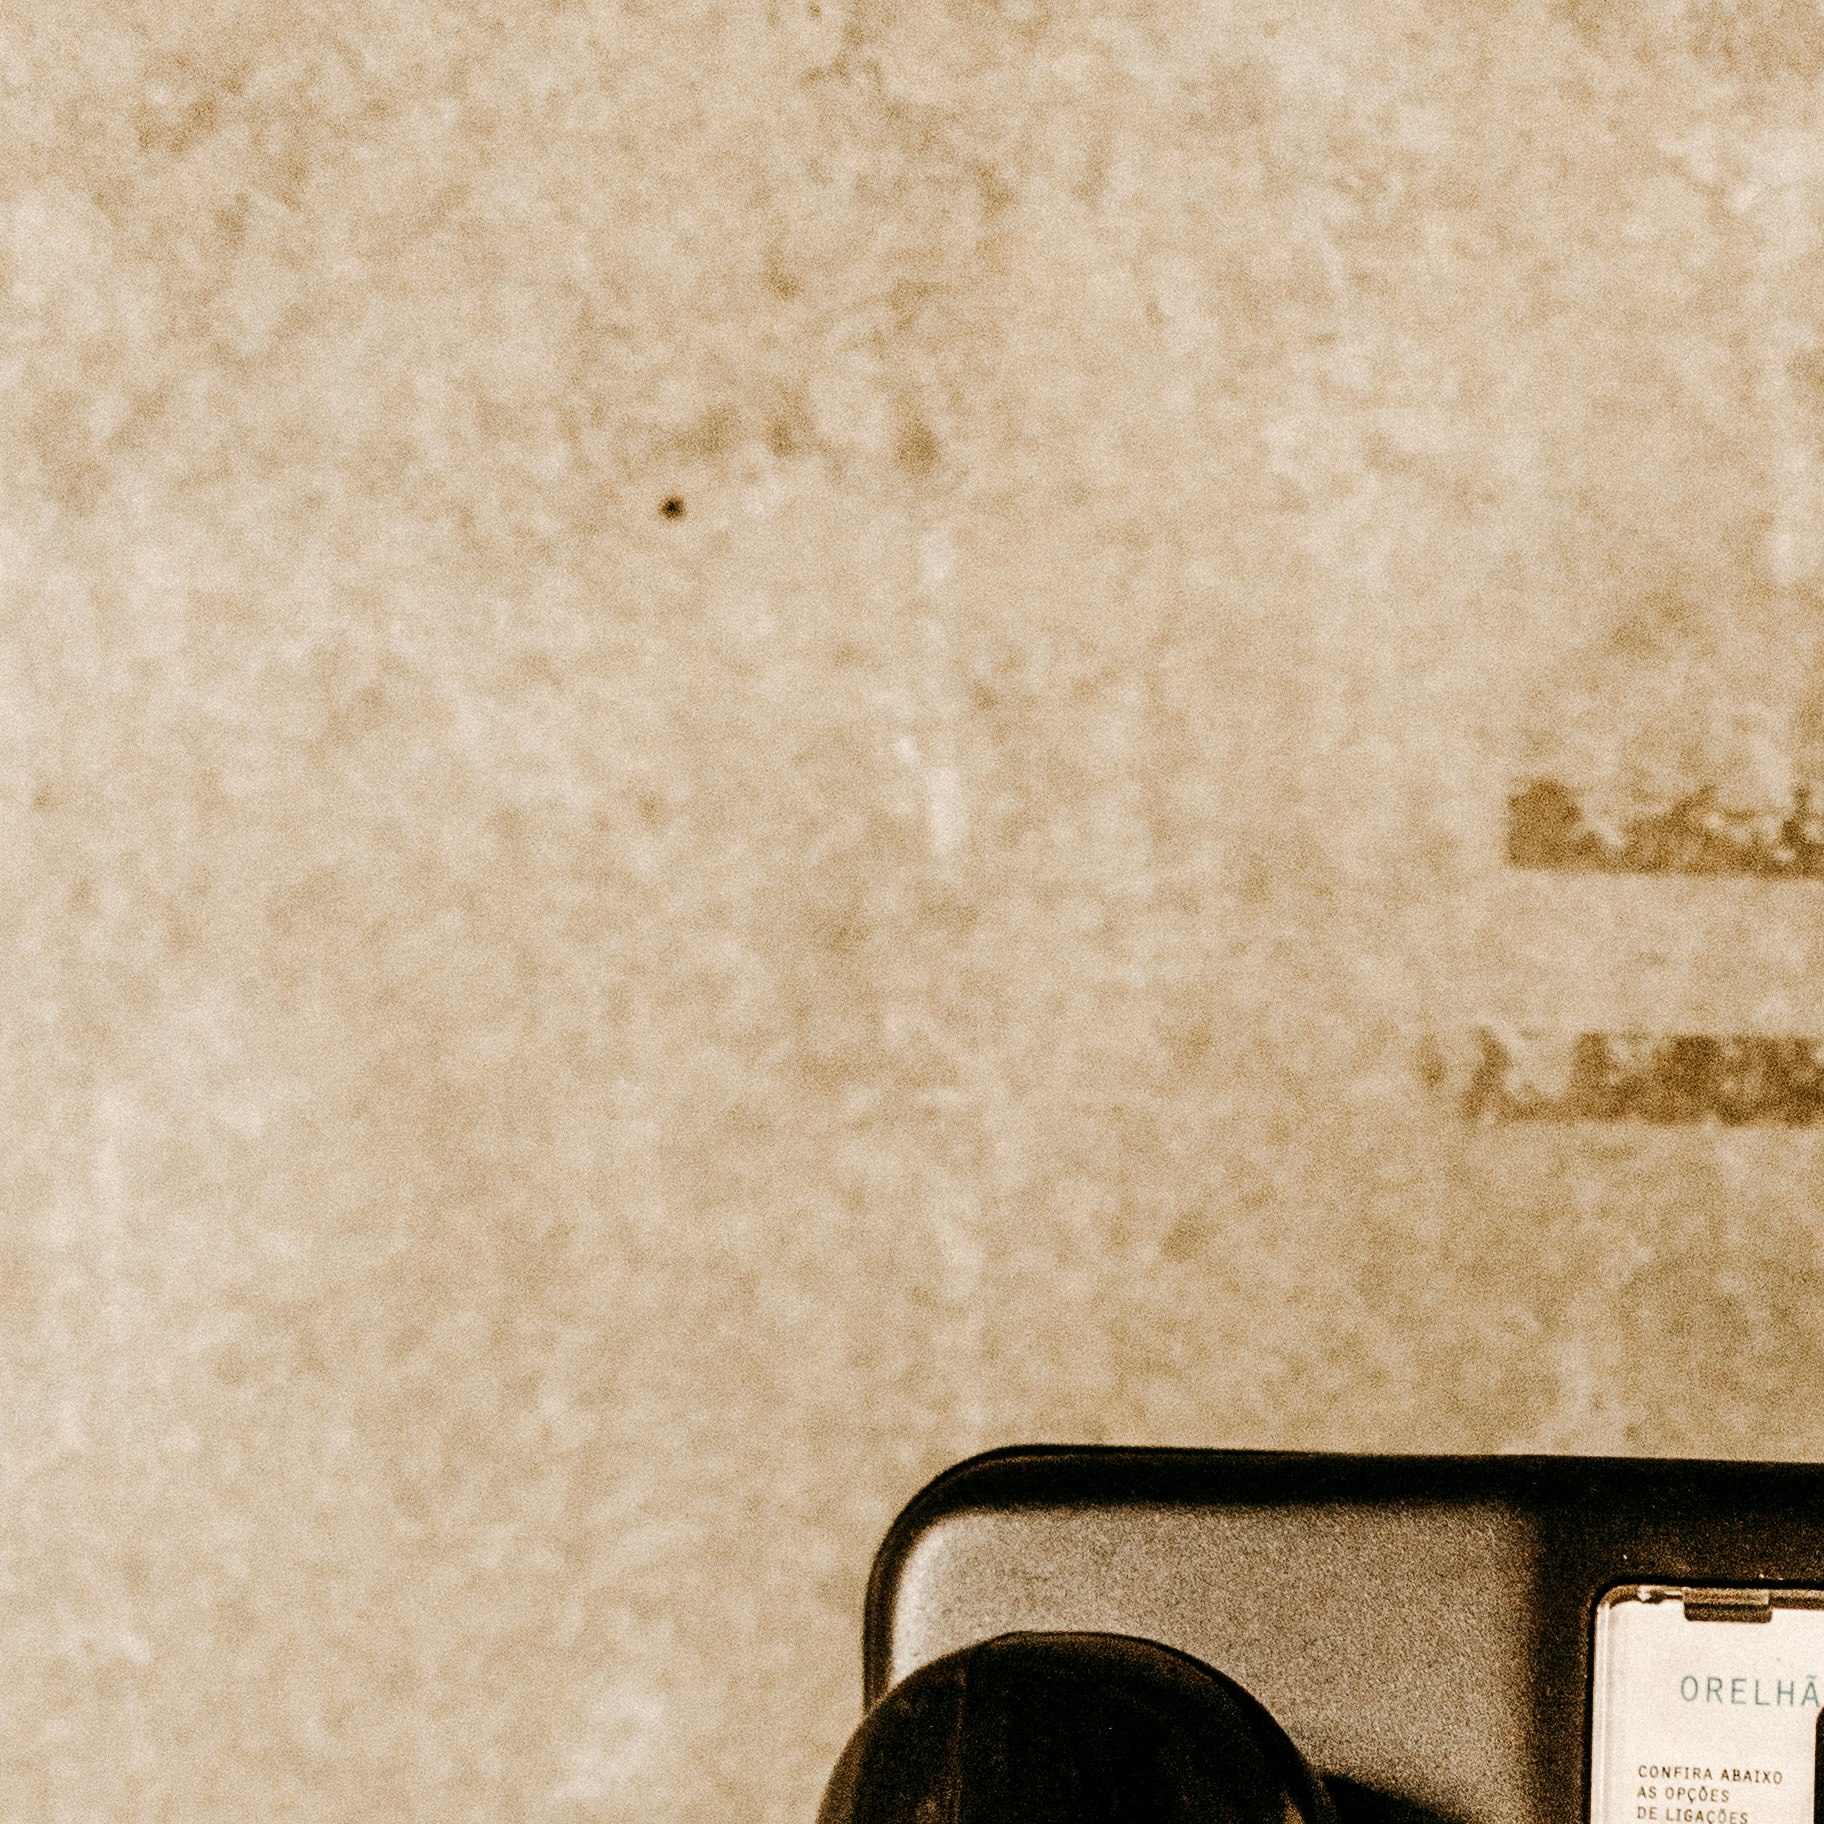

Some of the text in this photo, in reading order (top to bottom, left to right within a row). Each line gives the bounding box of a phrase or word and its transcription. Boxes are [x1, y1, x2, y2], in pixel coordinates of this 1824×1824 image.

[1638, 1765, 1783, 1784] CONFIRA ABAIXO
[1637, 1786, 1729, 1803] AS OPÇÕES
[1637, 1806, 1656, 1820] DE
